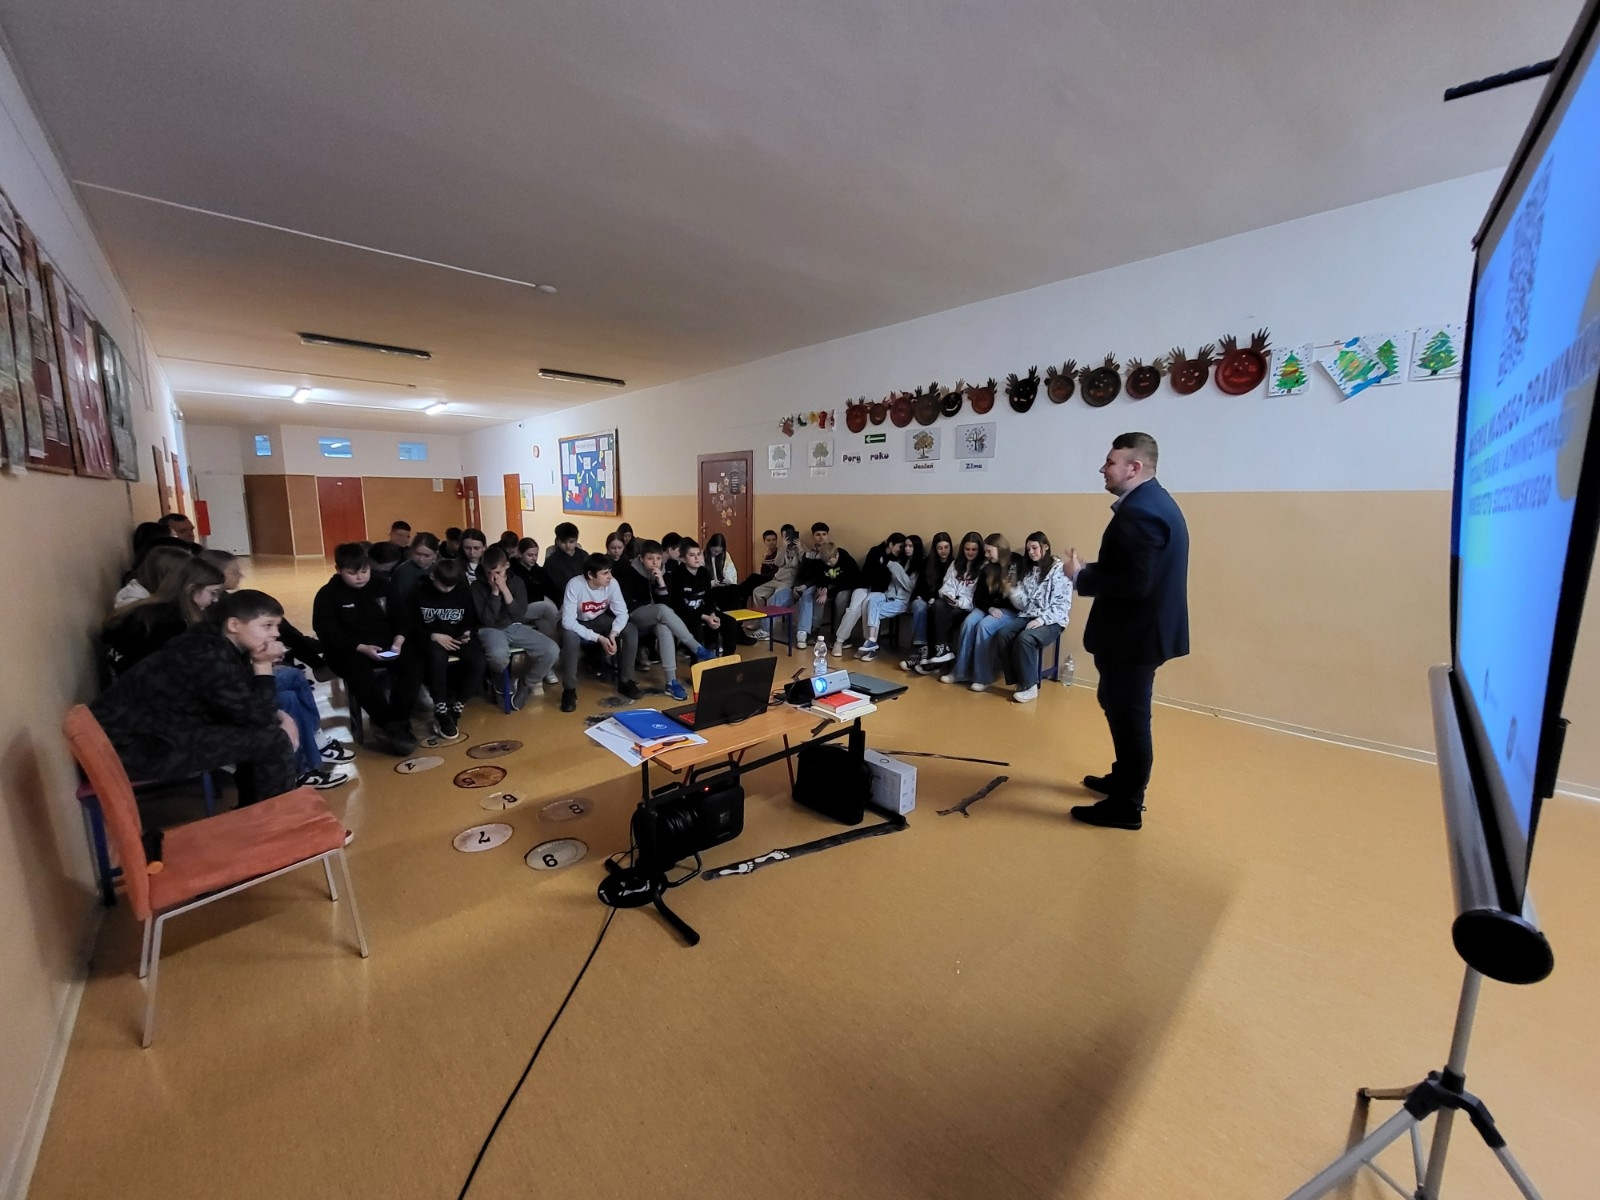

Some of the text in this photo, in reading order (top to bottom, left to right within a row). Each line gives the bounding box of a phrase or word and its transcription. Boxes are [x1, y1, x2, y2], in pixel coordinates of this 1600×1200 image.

[842, 452, 889, 463] Pory roku
[568, 804, 584, 814] 8
[478, 831, 491, 844] 7
